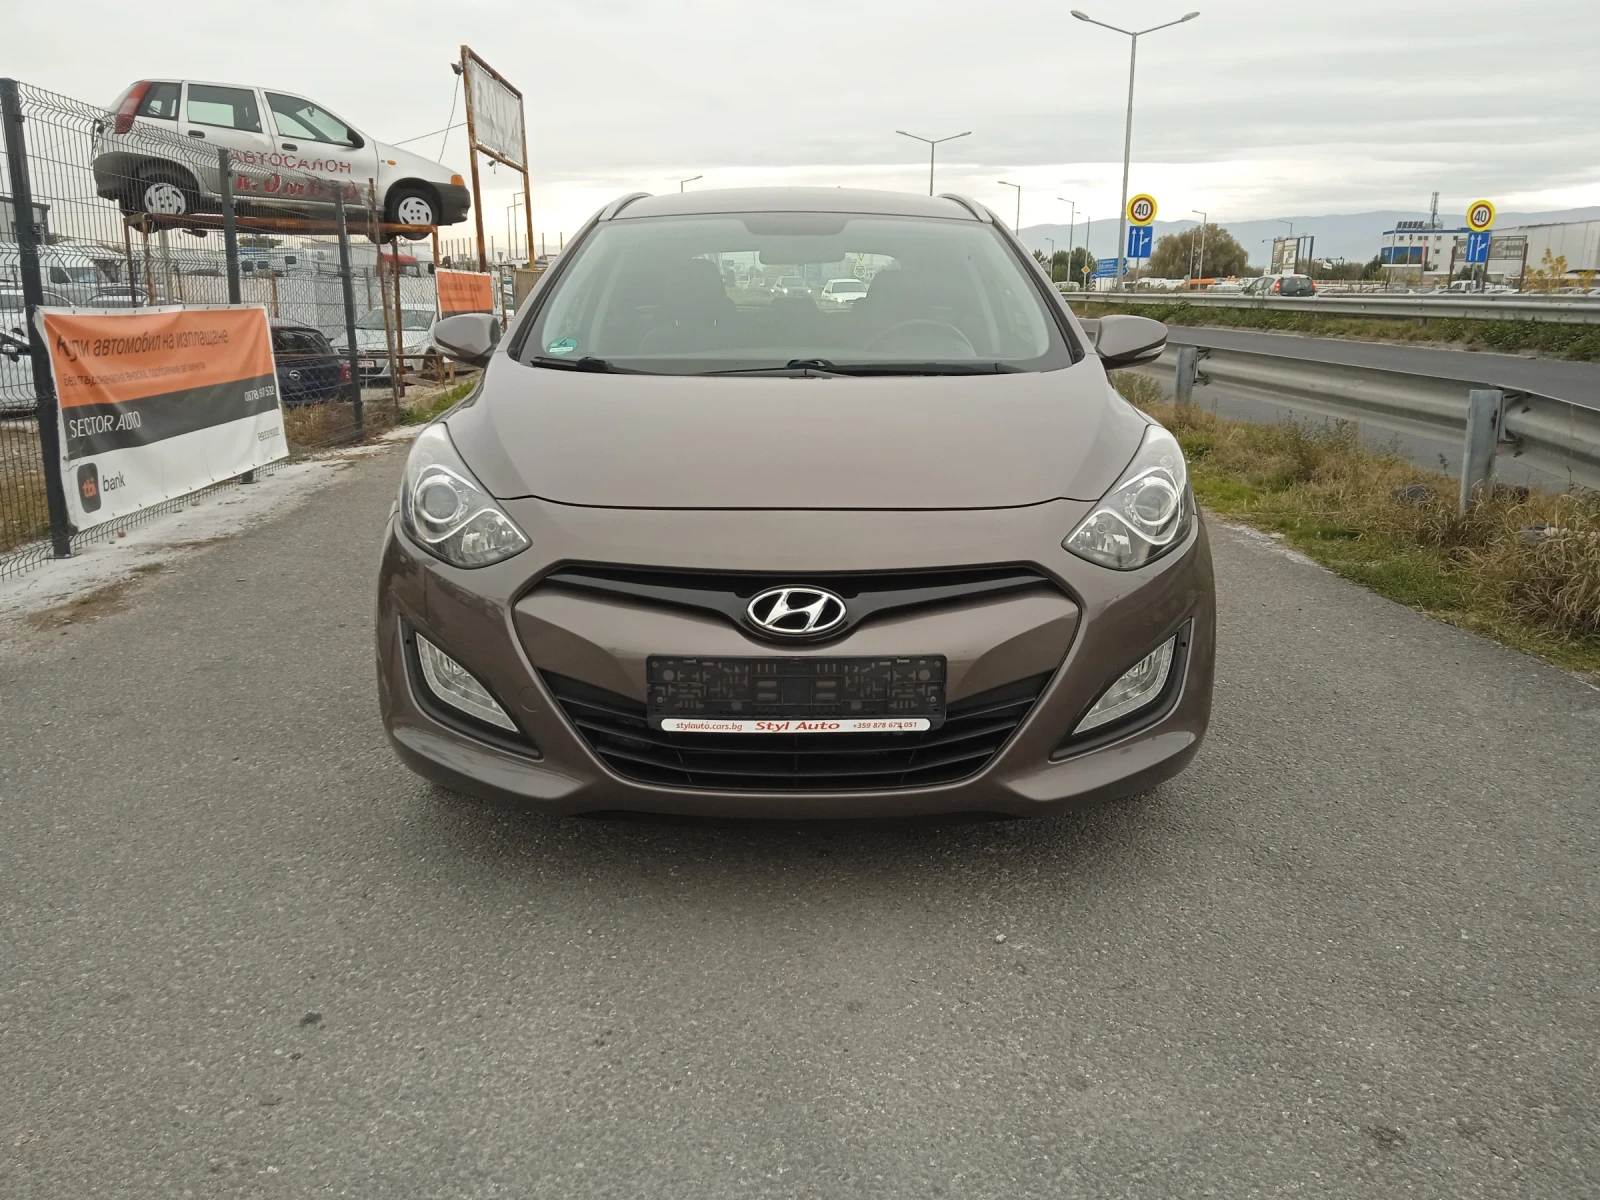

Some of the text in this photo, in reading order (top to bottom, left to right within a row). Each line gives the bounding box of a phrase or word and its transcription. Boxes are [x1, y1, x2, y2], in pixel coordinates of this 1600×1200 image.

[230, 150, 352, 175] АВТОСАЛОН
[1135, 203, 1149, 216] 40
[1474, 210, 1487, 223] 40
[93, 331, 161, 357] автомобил
[162, 333, 174, 350] на
[176, 329, 229, 348] изплащане
[69, 411, 141, 438] SECTOR AUTO
[82, 471, 126, 498] tbi bank
[676, 721, 743, 731] stylauto.cars.bg
[755, 721, 790, 731] Styl
[795, 721, 841, 730] Auto
[872, 721, 887, 729] 878
